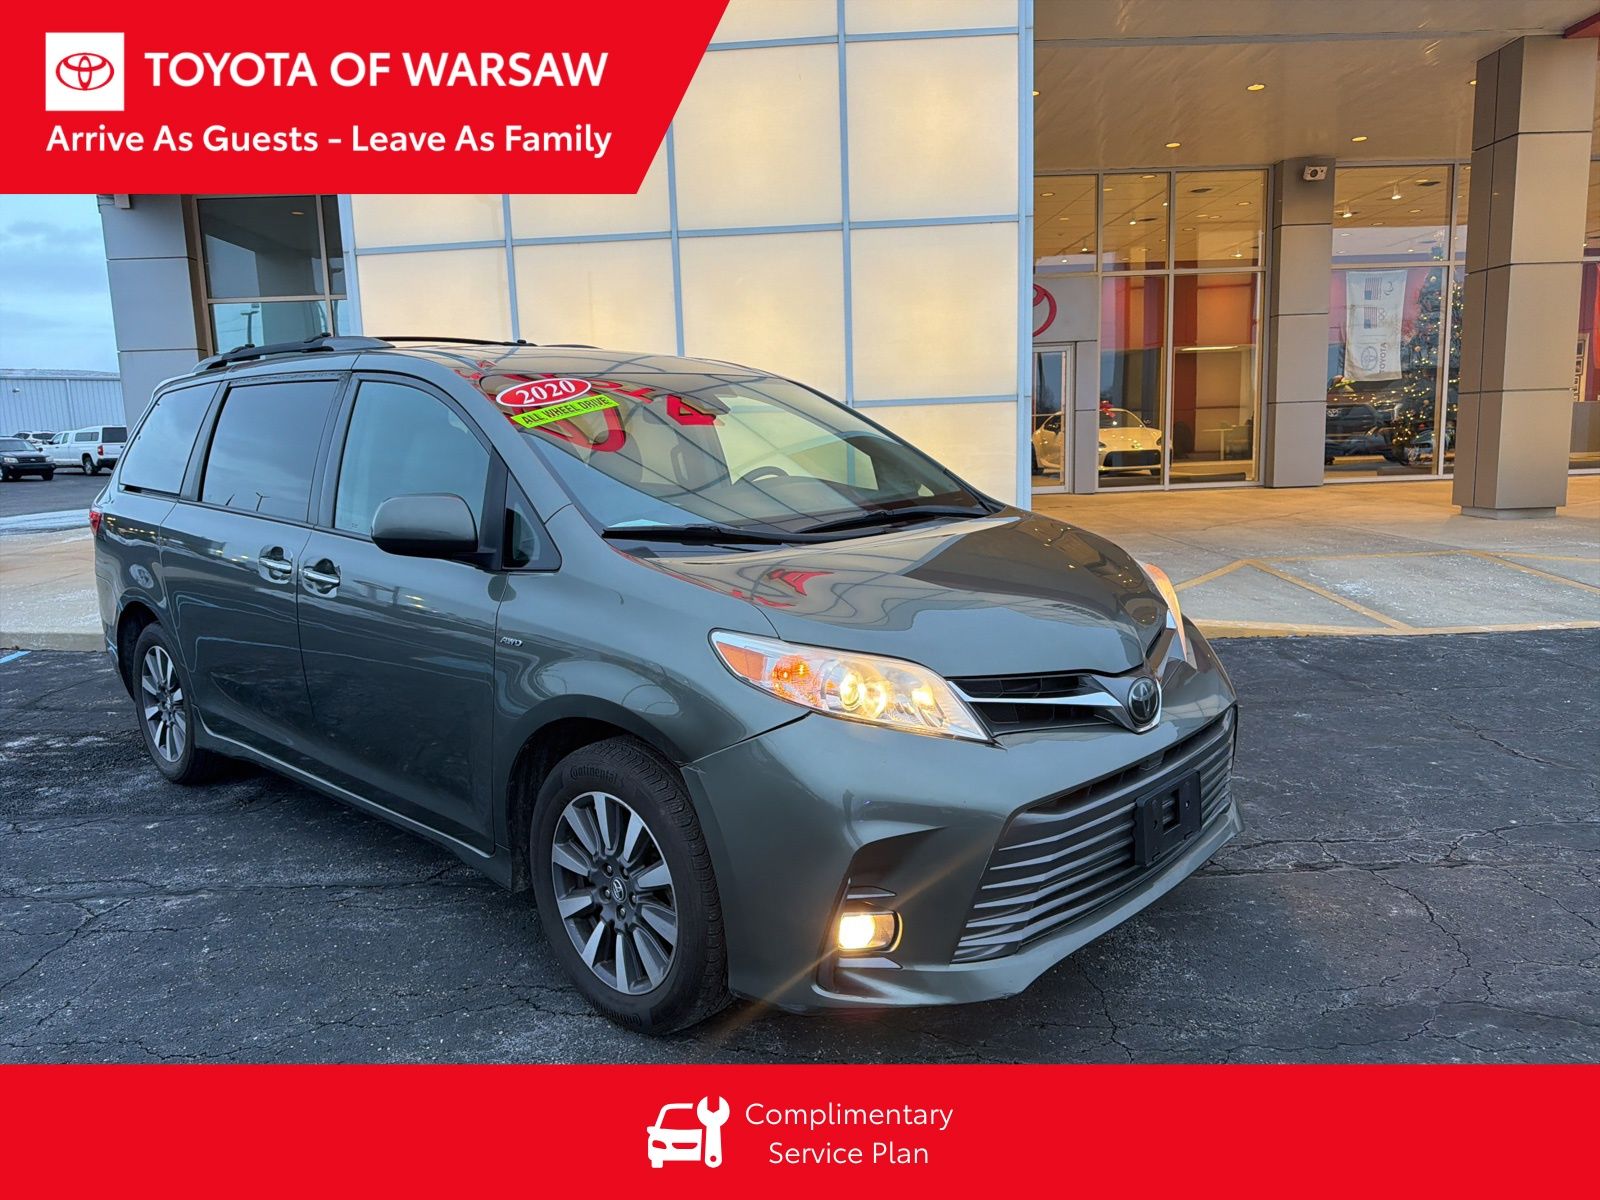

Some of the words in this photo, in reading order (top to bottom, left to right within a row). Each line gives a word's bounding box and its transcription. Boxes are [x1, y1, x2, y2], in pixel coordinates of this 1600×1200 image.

[515, 380, 576, 404] 2020
[522, 411, 543, 426] ALL
[547, 402, 579, 419] WHEEL
[580, 395, 610, 411] DRIVE
[500, 636, 522, 647] AWD
[570, 765, 618, 784] Continental
